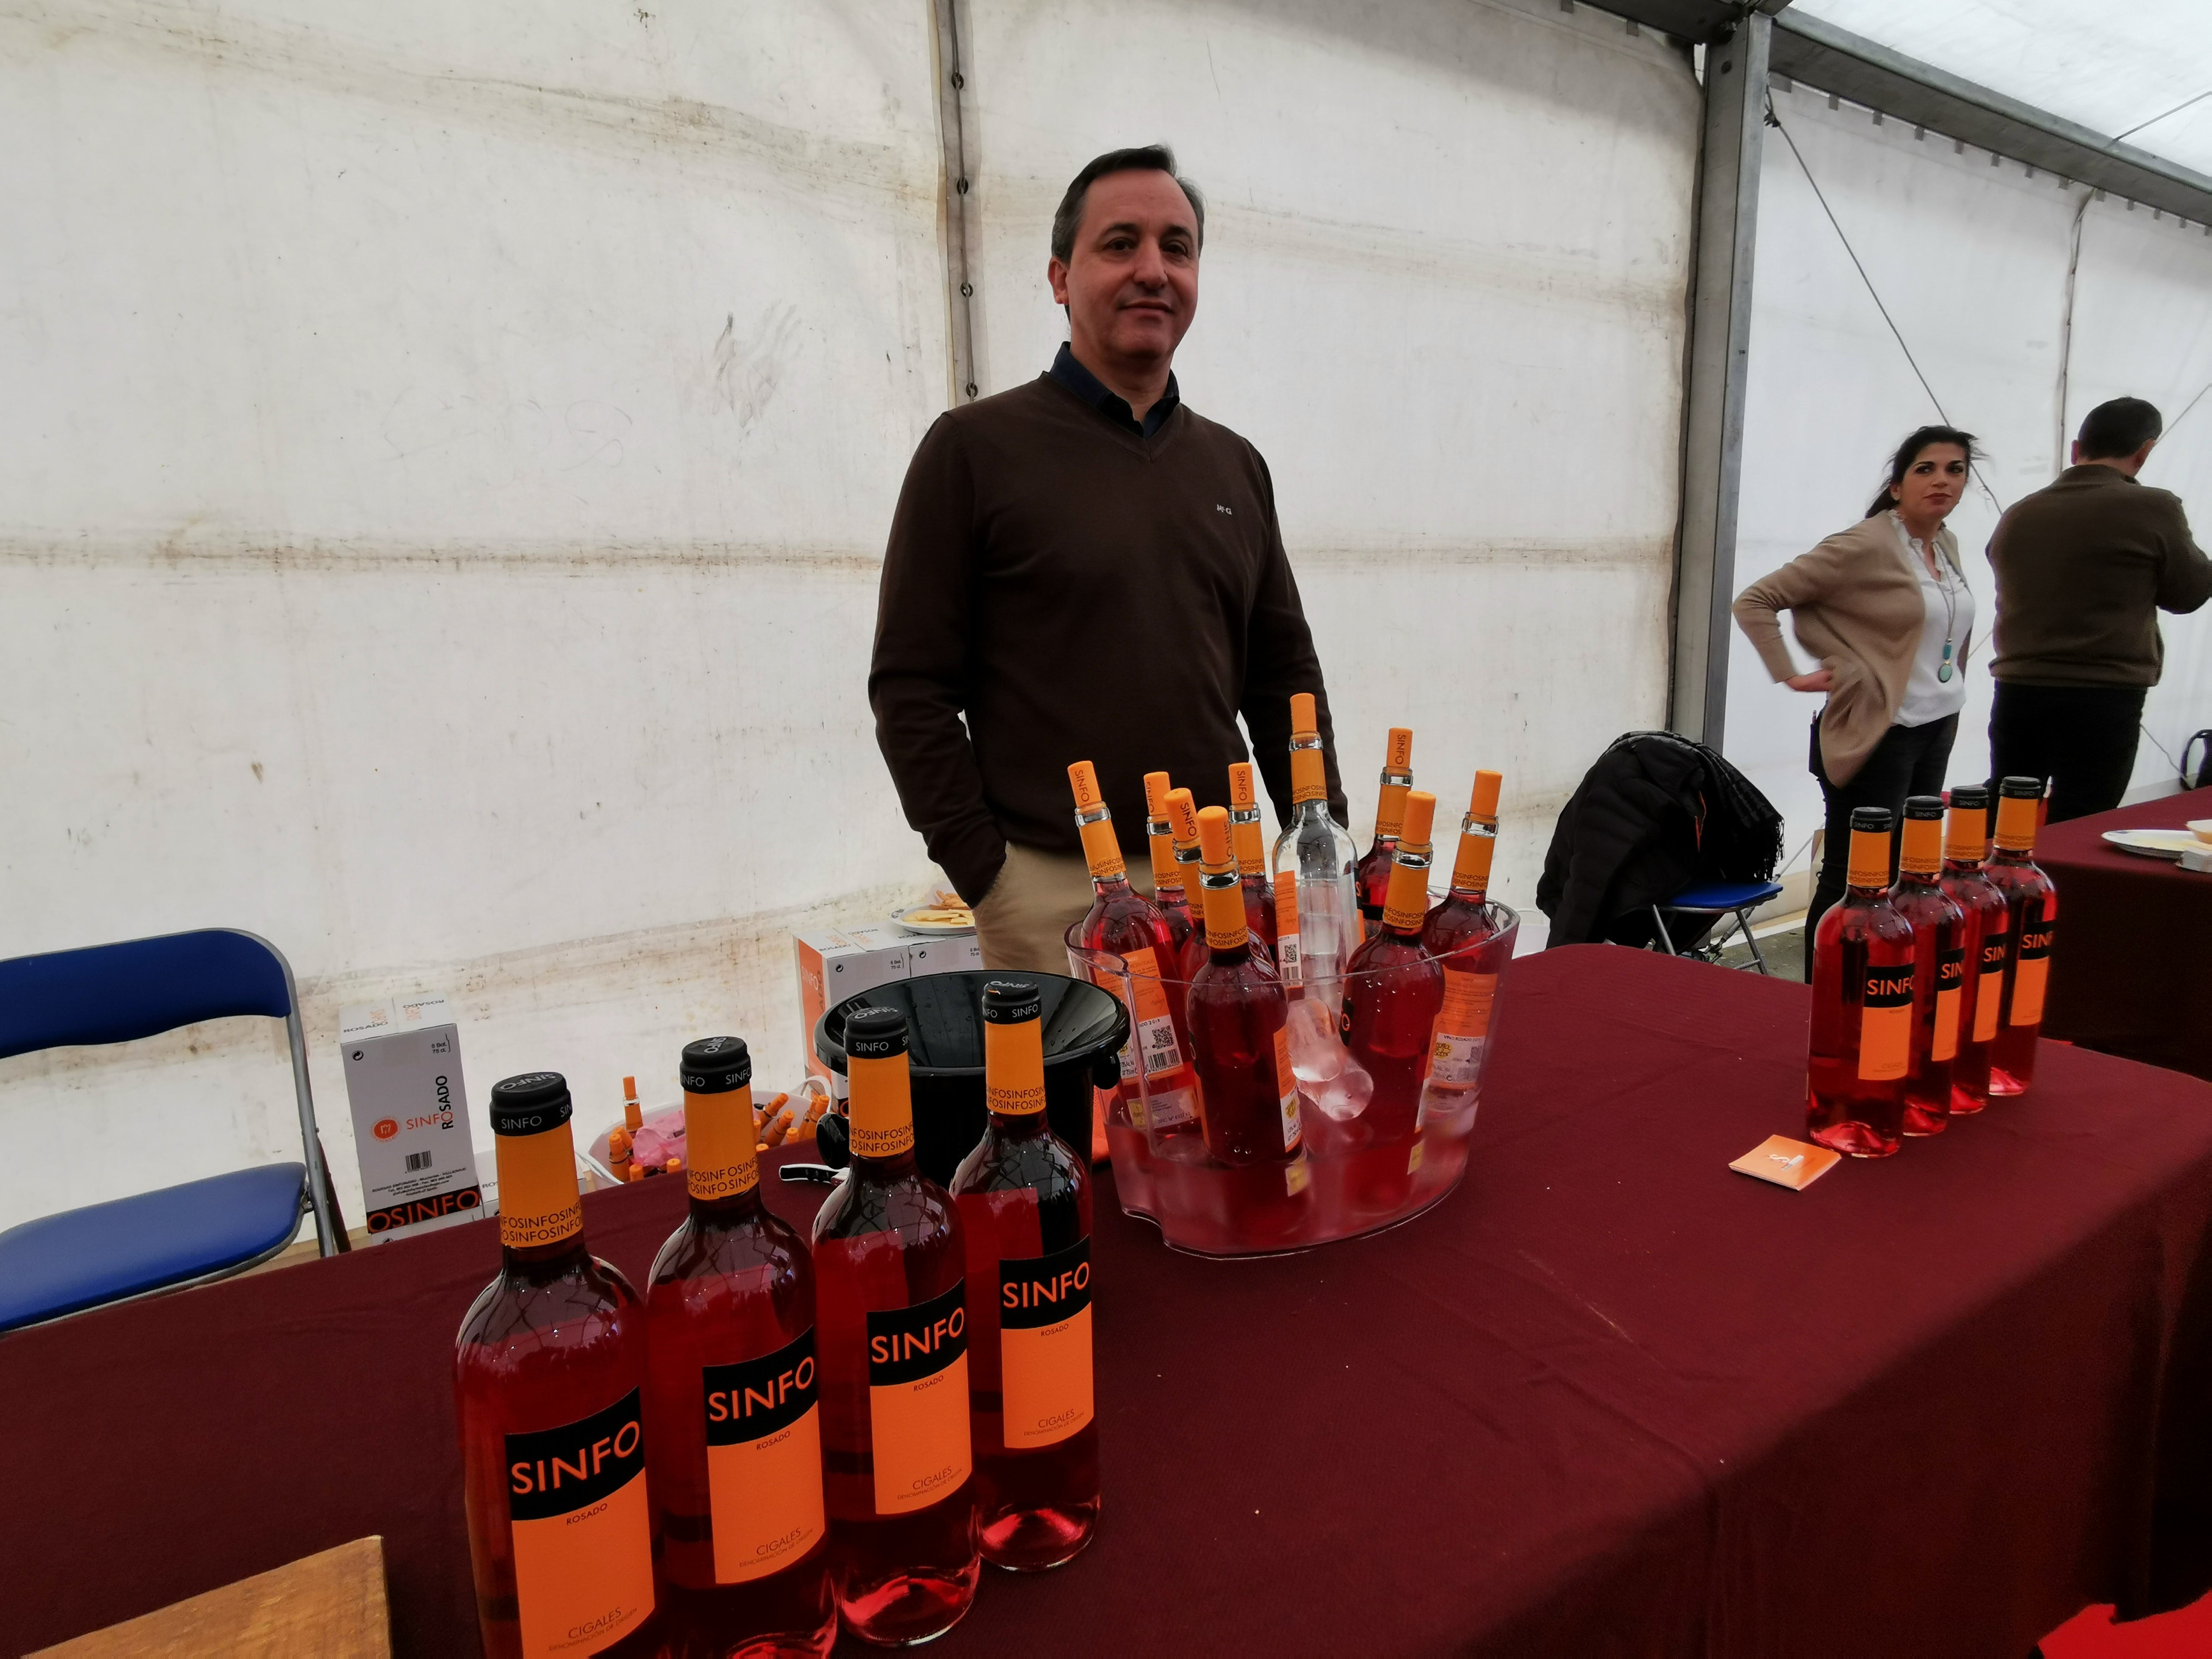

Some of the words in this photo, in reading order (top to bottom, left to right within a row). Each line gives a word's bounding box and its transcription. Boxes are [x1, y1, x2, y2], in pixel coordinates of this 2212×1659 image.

[1395, 734, 1406, 765] SINFO
[1075, 769, 1090, 802] SINFO
[1237, 770, 1247, 801] SINFO
[1146, 782, 1154, 813] SINFO
[1180, 802, 1197, 836] SINFO
[1983, 945, 2006, 962] SIN
[1941, 962, 1962, 979] SIN
[403, 999, 445, 1008] ROSADO
[1012, 1004, 1038, 1018] SINFO
[854, 1006, 899, 1020] SINFO
[983, 1008, 998, 1018] NFO
[343, 1021, 388, 1033] ROSADO
[703, 1037, 728, 1054] SINFO
[855, 1042, 889, 1052] SINFO
[499, 1073, 556, 1090] SINFO
[681, 1073, 705, 1087] NFO
[725, 1067, 752, 1085] SINFO
[406, 1111, 453, 1129] SINFO
[560, 1104, 573, 1118] SIN
[501, 1116, 542, 1129] SINFO
[367, 1190, 480, 1234] OSINFO
[1003, 1262, 1090, 1308] SINFO
[871, 1307, 965, 1364] SINFO
[1041, 1323, 1069, 1337] ROSADO
[709, 1356, 814, 1422] SINFO
[913, 1375, 944, 1392] ROSADO
[1038, 1408, 1074, 1428] CIGALES
[756, 1430, 791, 1451] ROSADO
[511, 1421, 640, 1494] SINFO
[912, 1465, 952, 1491] CIGALES
[566, 1503, 608, 1526] ROSADO
[756, 1527, 801, 1555] CIGALES
[788, 1543, 795, 1551] DE
[568, 1607, 622, 1640] CIGALES
[606, 1623, 614, 1633] DE
